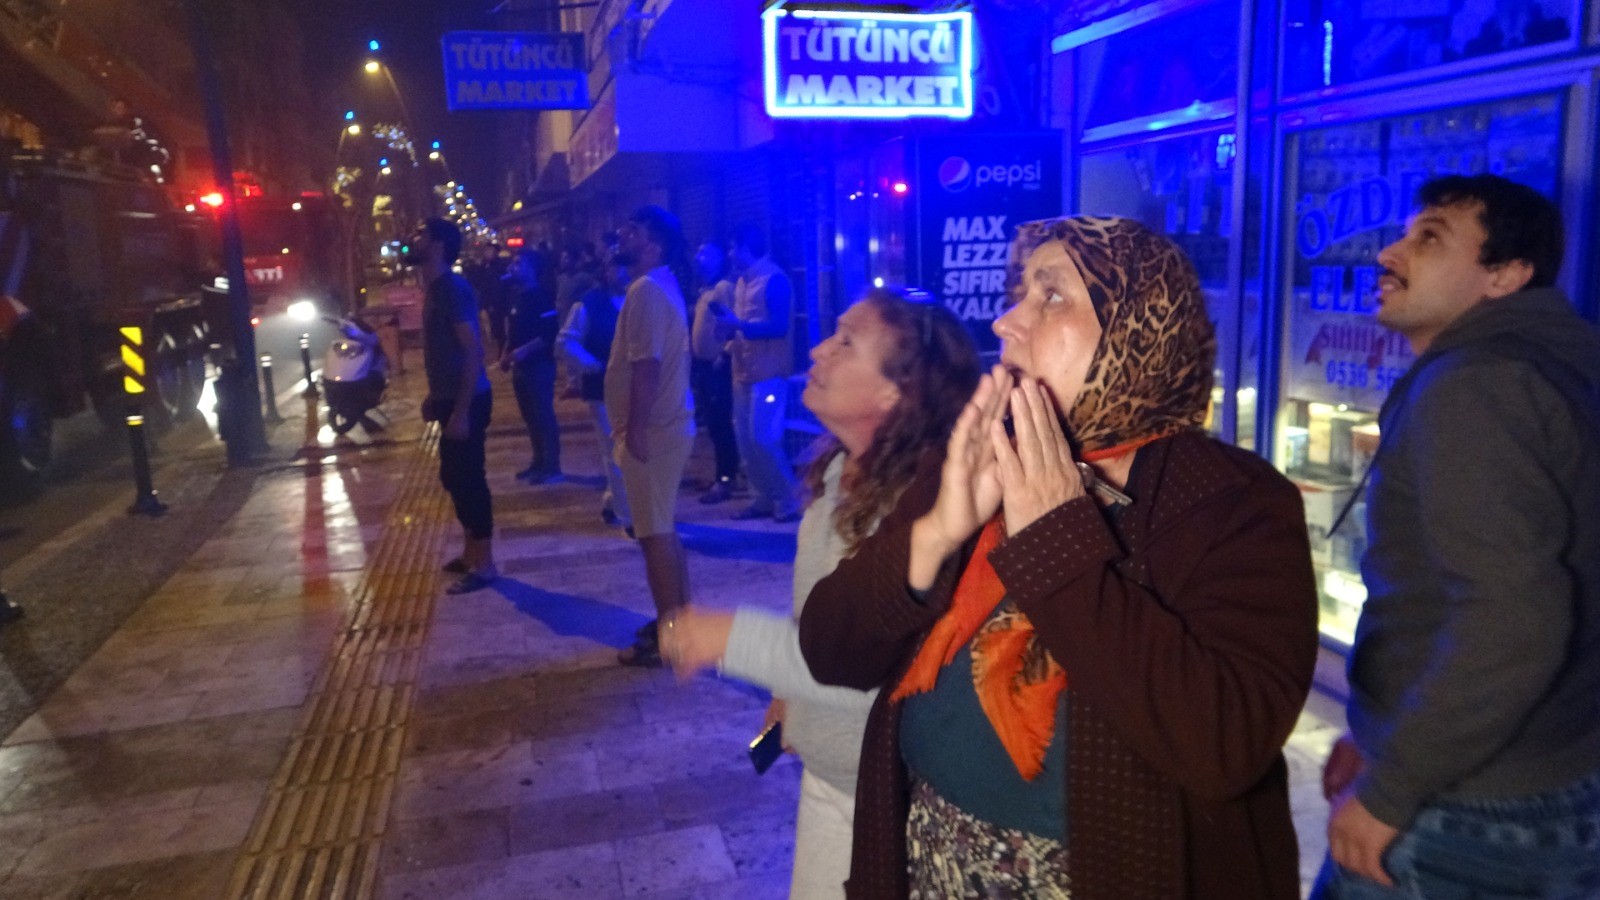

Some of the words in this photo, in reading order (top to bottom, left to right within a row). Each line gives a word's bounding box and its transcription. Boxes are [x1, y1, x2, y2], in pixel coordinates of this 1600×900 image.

[451, 37, 574, 70] TÜTÜNCÜ
[457, 80, 577, 103] MARKET
[784, 73, 959, 106] MARKET
[975, 160, 1041, 188] pepsi
[942, 215, 1007, 242] MAX
